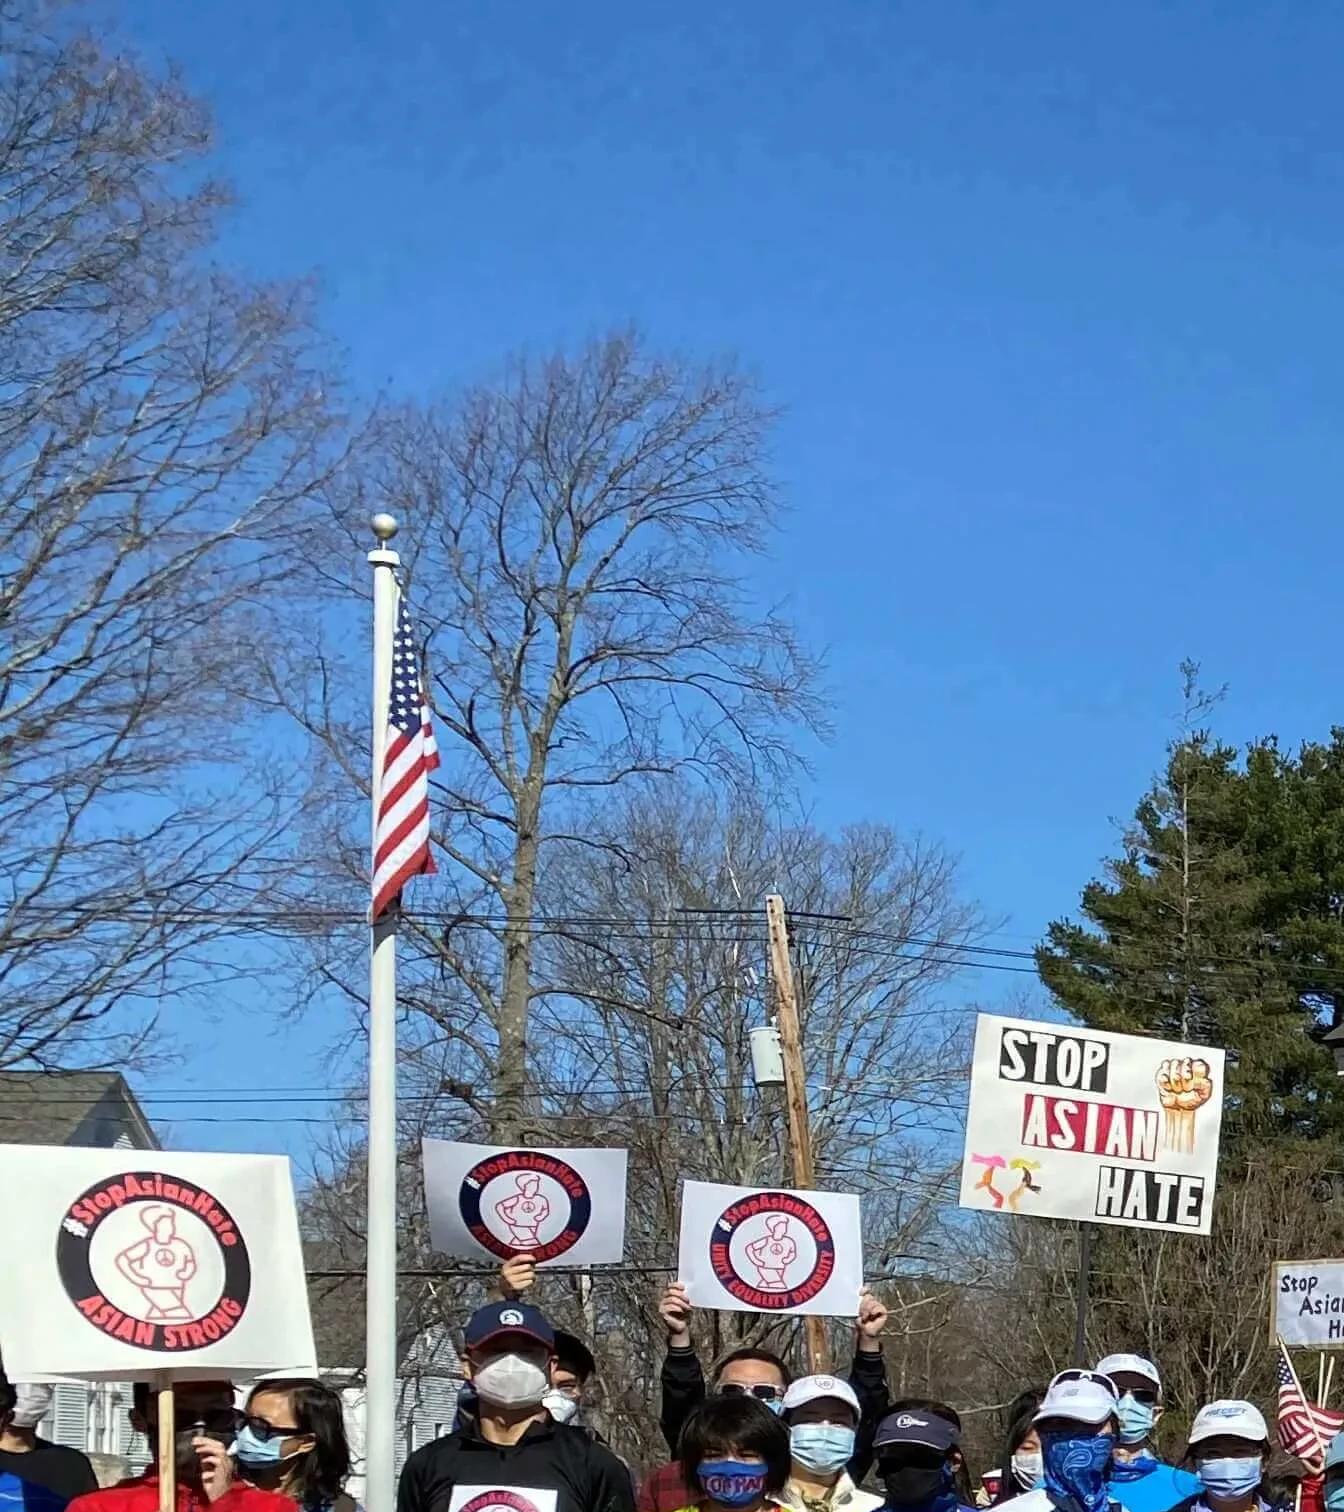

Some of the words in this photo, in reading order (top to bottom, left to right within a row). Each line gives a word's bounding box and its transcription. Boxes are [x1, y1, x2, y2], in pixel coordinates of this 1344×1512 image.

[1001, 1030, 1107, 1091] STOP
[1023, 1095, 1159, 1161] ASIAN
[63, 1175, 238, 1246] #StopAsianHate
[718, 1194, 828, 1242] #StopAsianHate
[1096, 1166, 1201, 1226] HATE
[711, 1243, 734, 1280] UNITY
[727, 1280, 790, 1307] EQUALITY
[791, 1250, 834, 1303] DIVERSITY
[1281, 1275, 1318, 1295] Stop
[77, 1295, 155, 1346] ASIAN
[163, 1297, 243, 1348] STRONG
